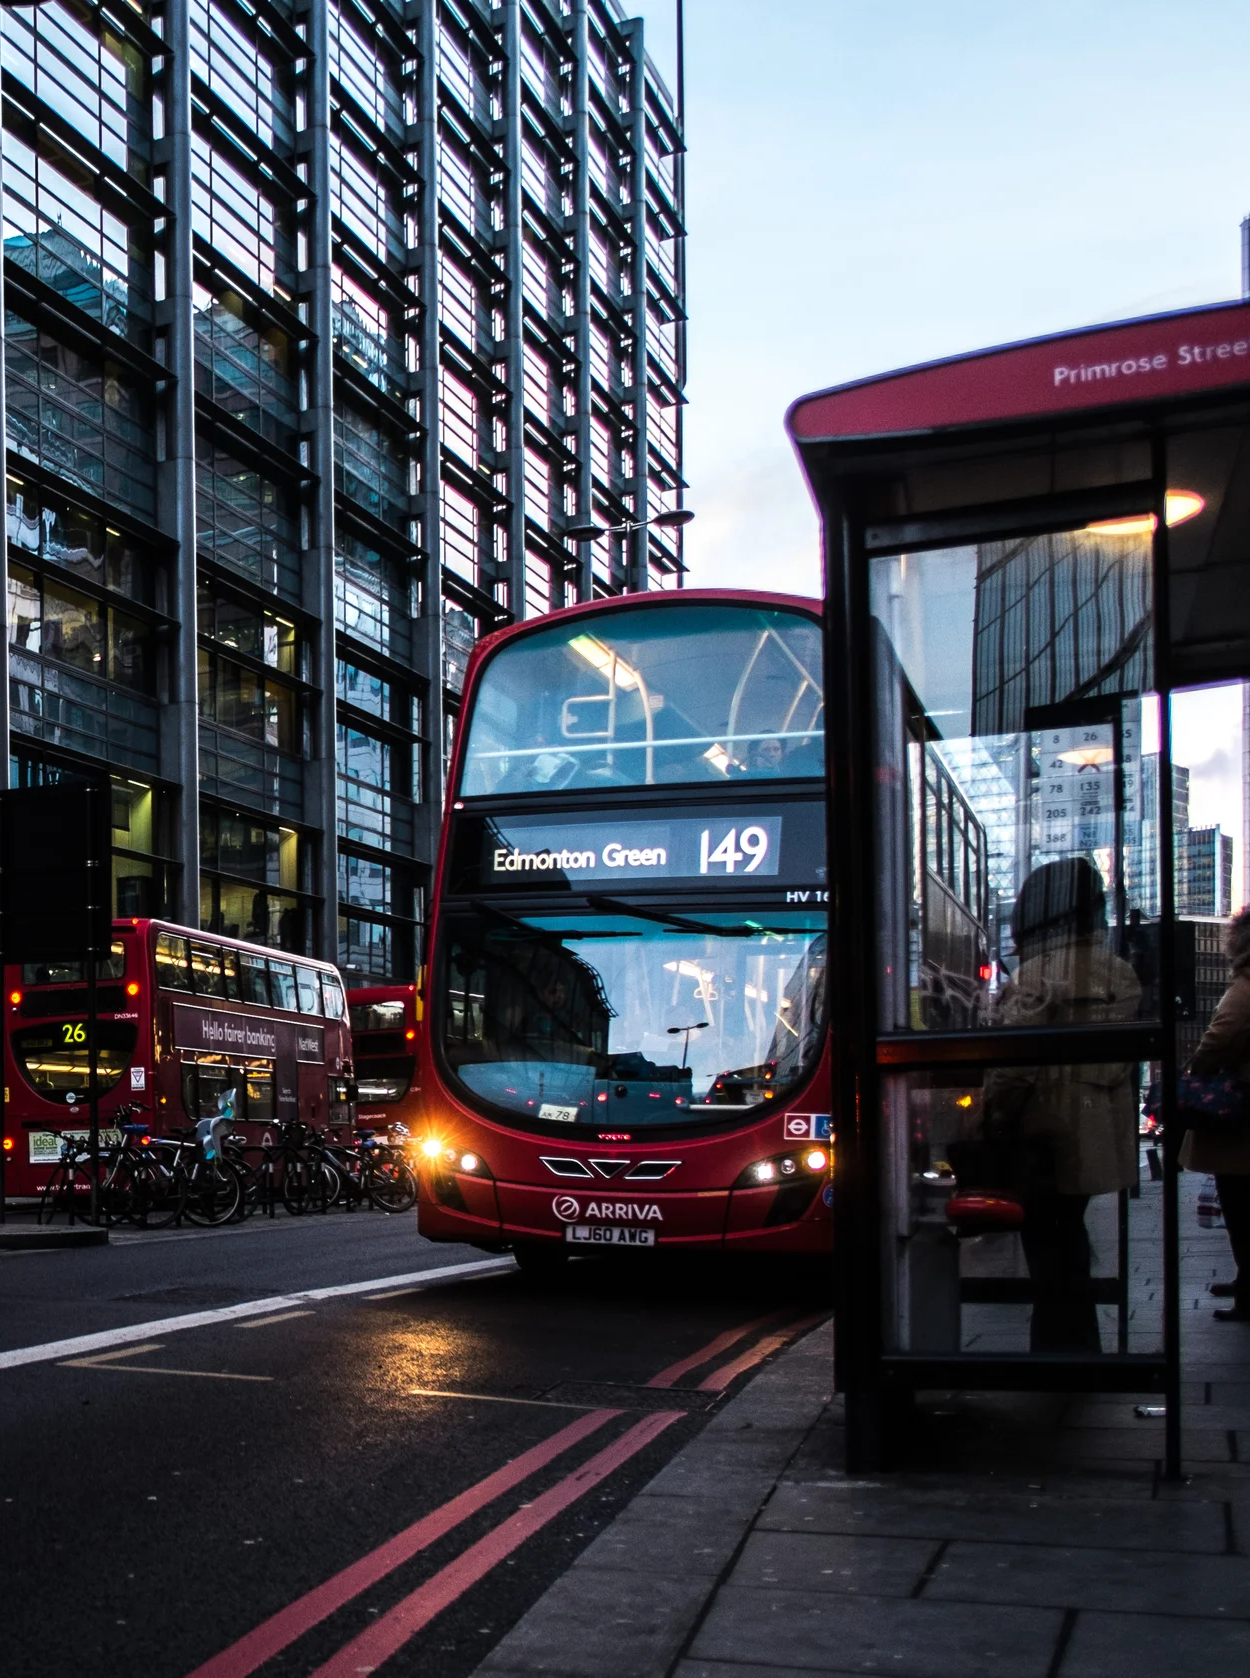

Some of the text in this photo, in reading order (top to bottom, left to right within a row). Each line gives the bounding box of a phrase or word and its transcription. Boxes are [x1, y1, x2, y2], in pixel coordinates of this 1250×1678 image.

[1053, 340, 1250, 387] Primrose Stree
[1052, 735, 1060, 744] 8
[1083, 732, 1098, 742] 26
[1049, 760, 1063, 769] 42
[1049, 782, 1101, 794] 78 135
[1046, 806, 1102, 819] 205 242
[493, 843, 667, 872] Edmonton Green
[700, 826, 769, 874] 149
[786, 890, 810, 903] HV
[62, 1022, 87, 1043] 26
[201, 1019, 276, 1052] Hello fairer banking
[298, 1036, 319, 1053] NatWest
[555, 1110, 570, 1121] 78
[33, 1136, 58, 1147] ideal
[584, 1201, 664, 1222] ARRIVA
[572, 1226, 649, 1244] LJ60 AWG
